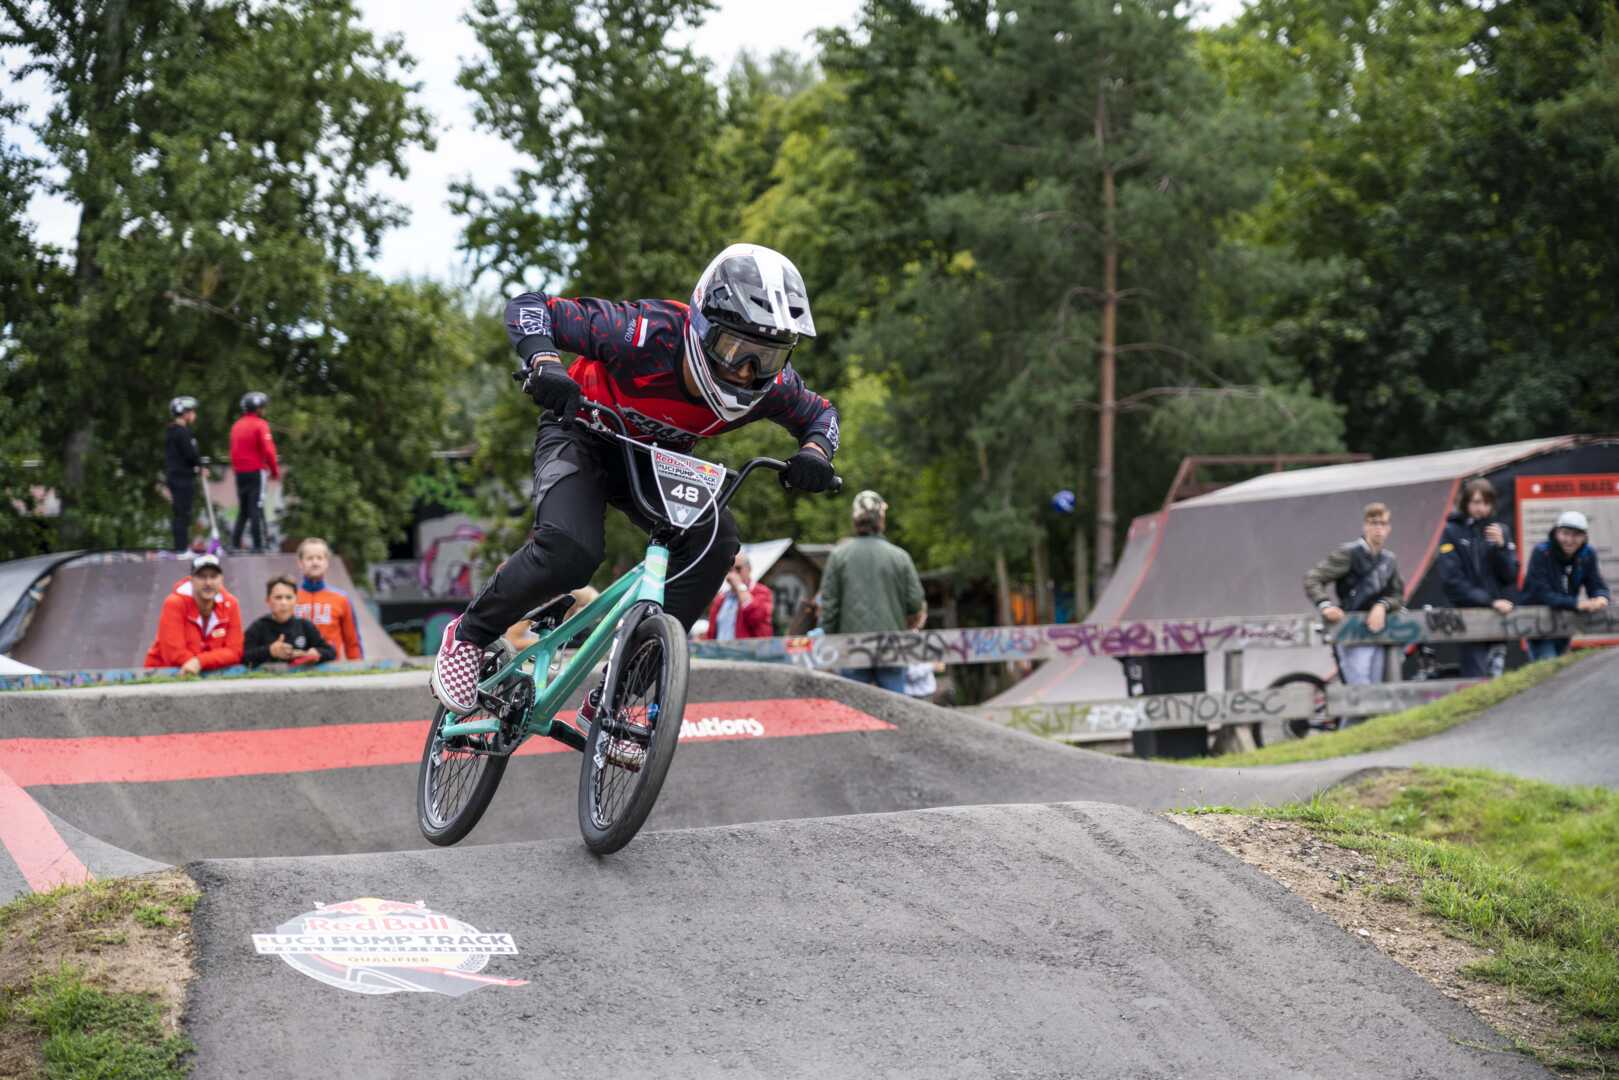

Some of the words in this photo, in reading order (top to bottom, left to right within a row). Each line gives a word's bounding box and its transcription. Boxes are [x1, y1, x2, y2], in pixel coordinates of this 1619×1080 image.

[656, 452, 673, 465] Red
[670, 483, 699, 503] 48
[678, 716, 764, 738] lutions
[306, 917, 378, 931] Red
[382, 916, 450, 931] Bull
[269, 935, 327, 946] UCI
[330, 935, 413, 946] PUMP
[418, 935, 511, 946] TRACK
